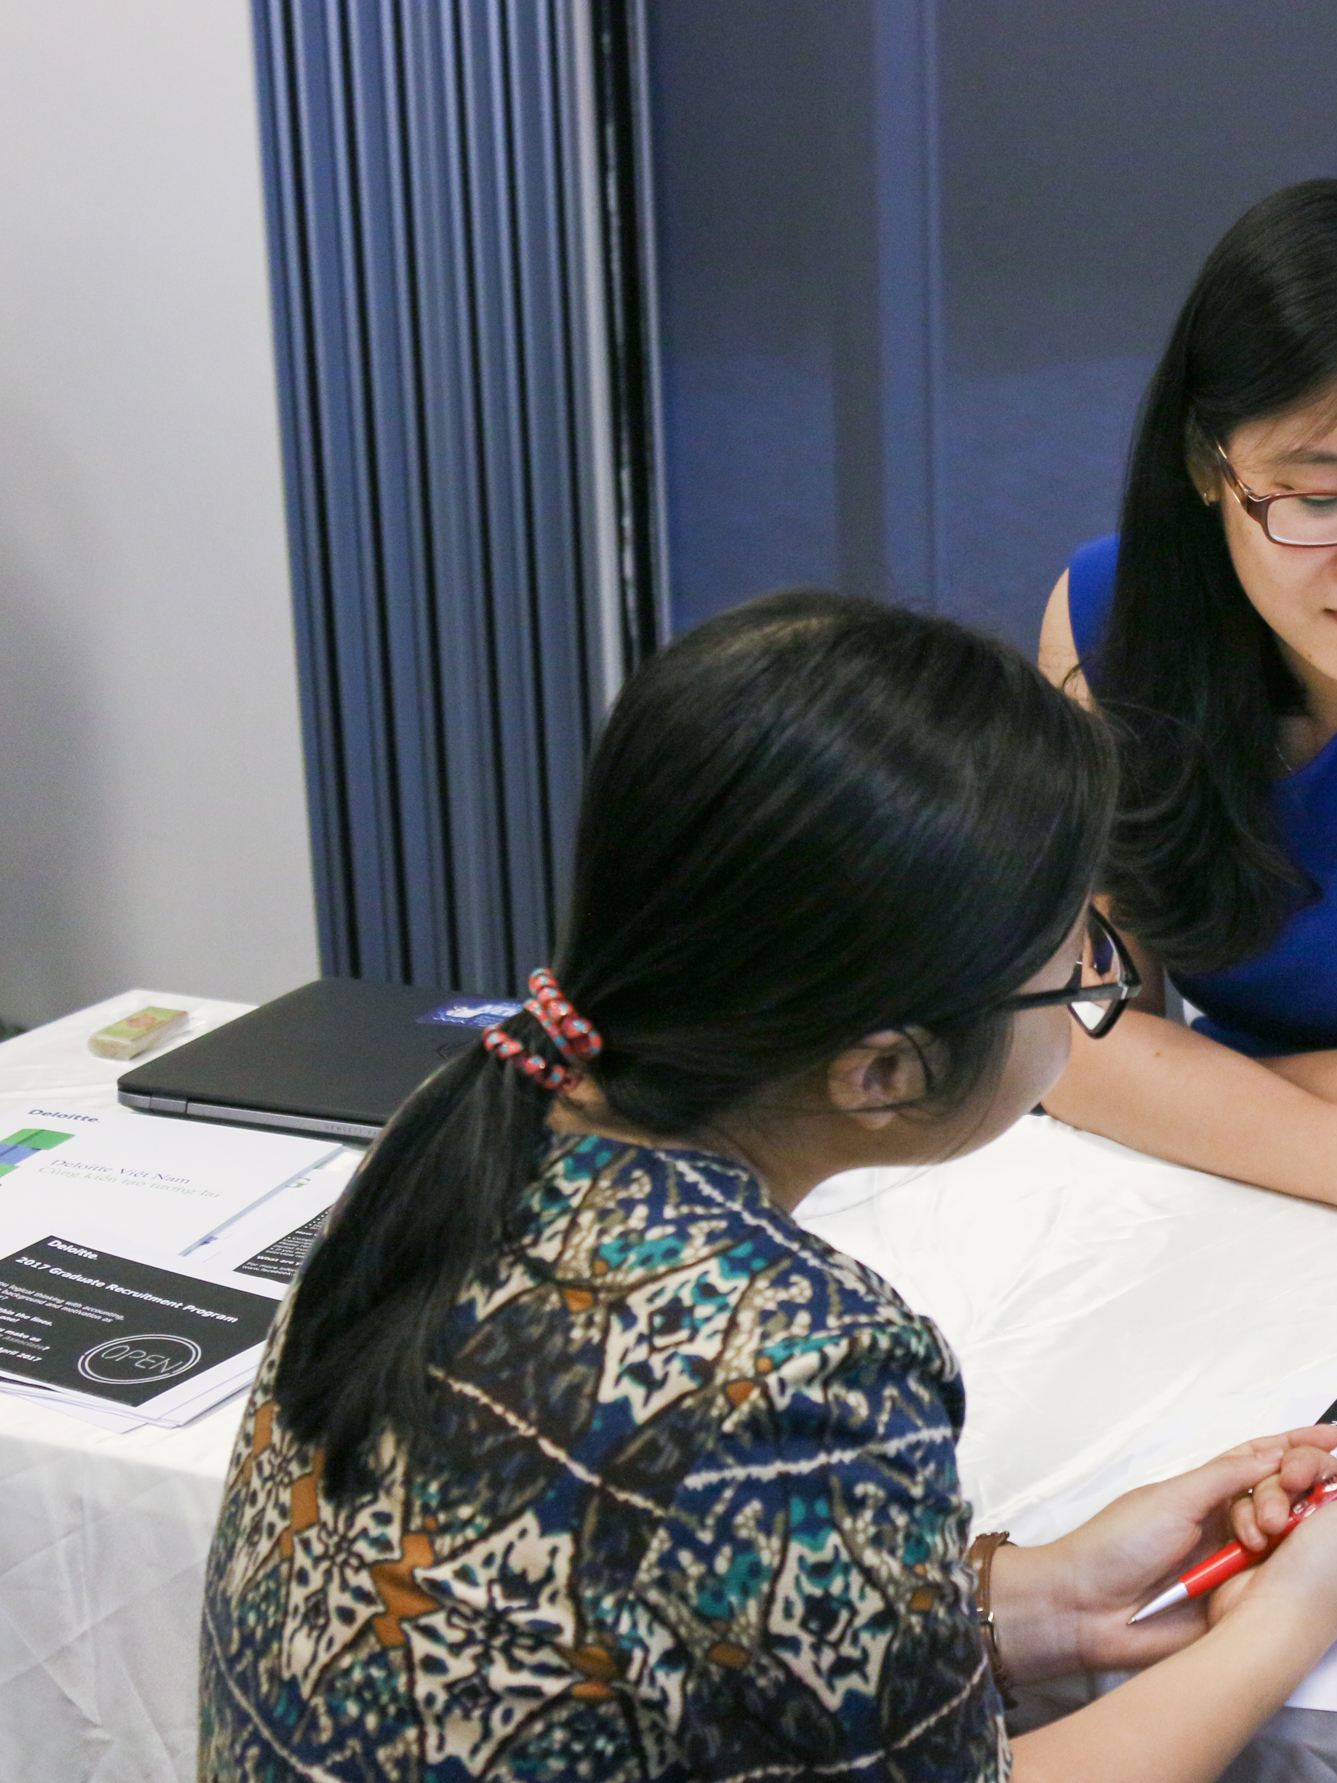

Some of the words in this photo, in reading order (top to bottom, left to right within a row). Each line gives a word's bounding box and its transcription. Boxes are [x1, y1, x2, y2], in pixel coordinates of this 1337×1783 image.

[153, 1172, 191, 1184] Nam
[16, 1256, 51, 1270] 2017
[49, 1267, 106, 1287] Graduate
[105, 1283, 183, 1309] Recruitment
[182, 1303, 239, 1324] Program
[16, 1353, 42, 1362] 2017
[100, 1344, 183, 1374] OPEN
